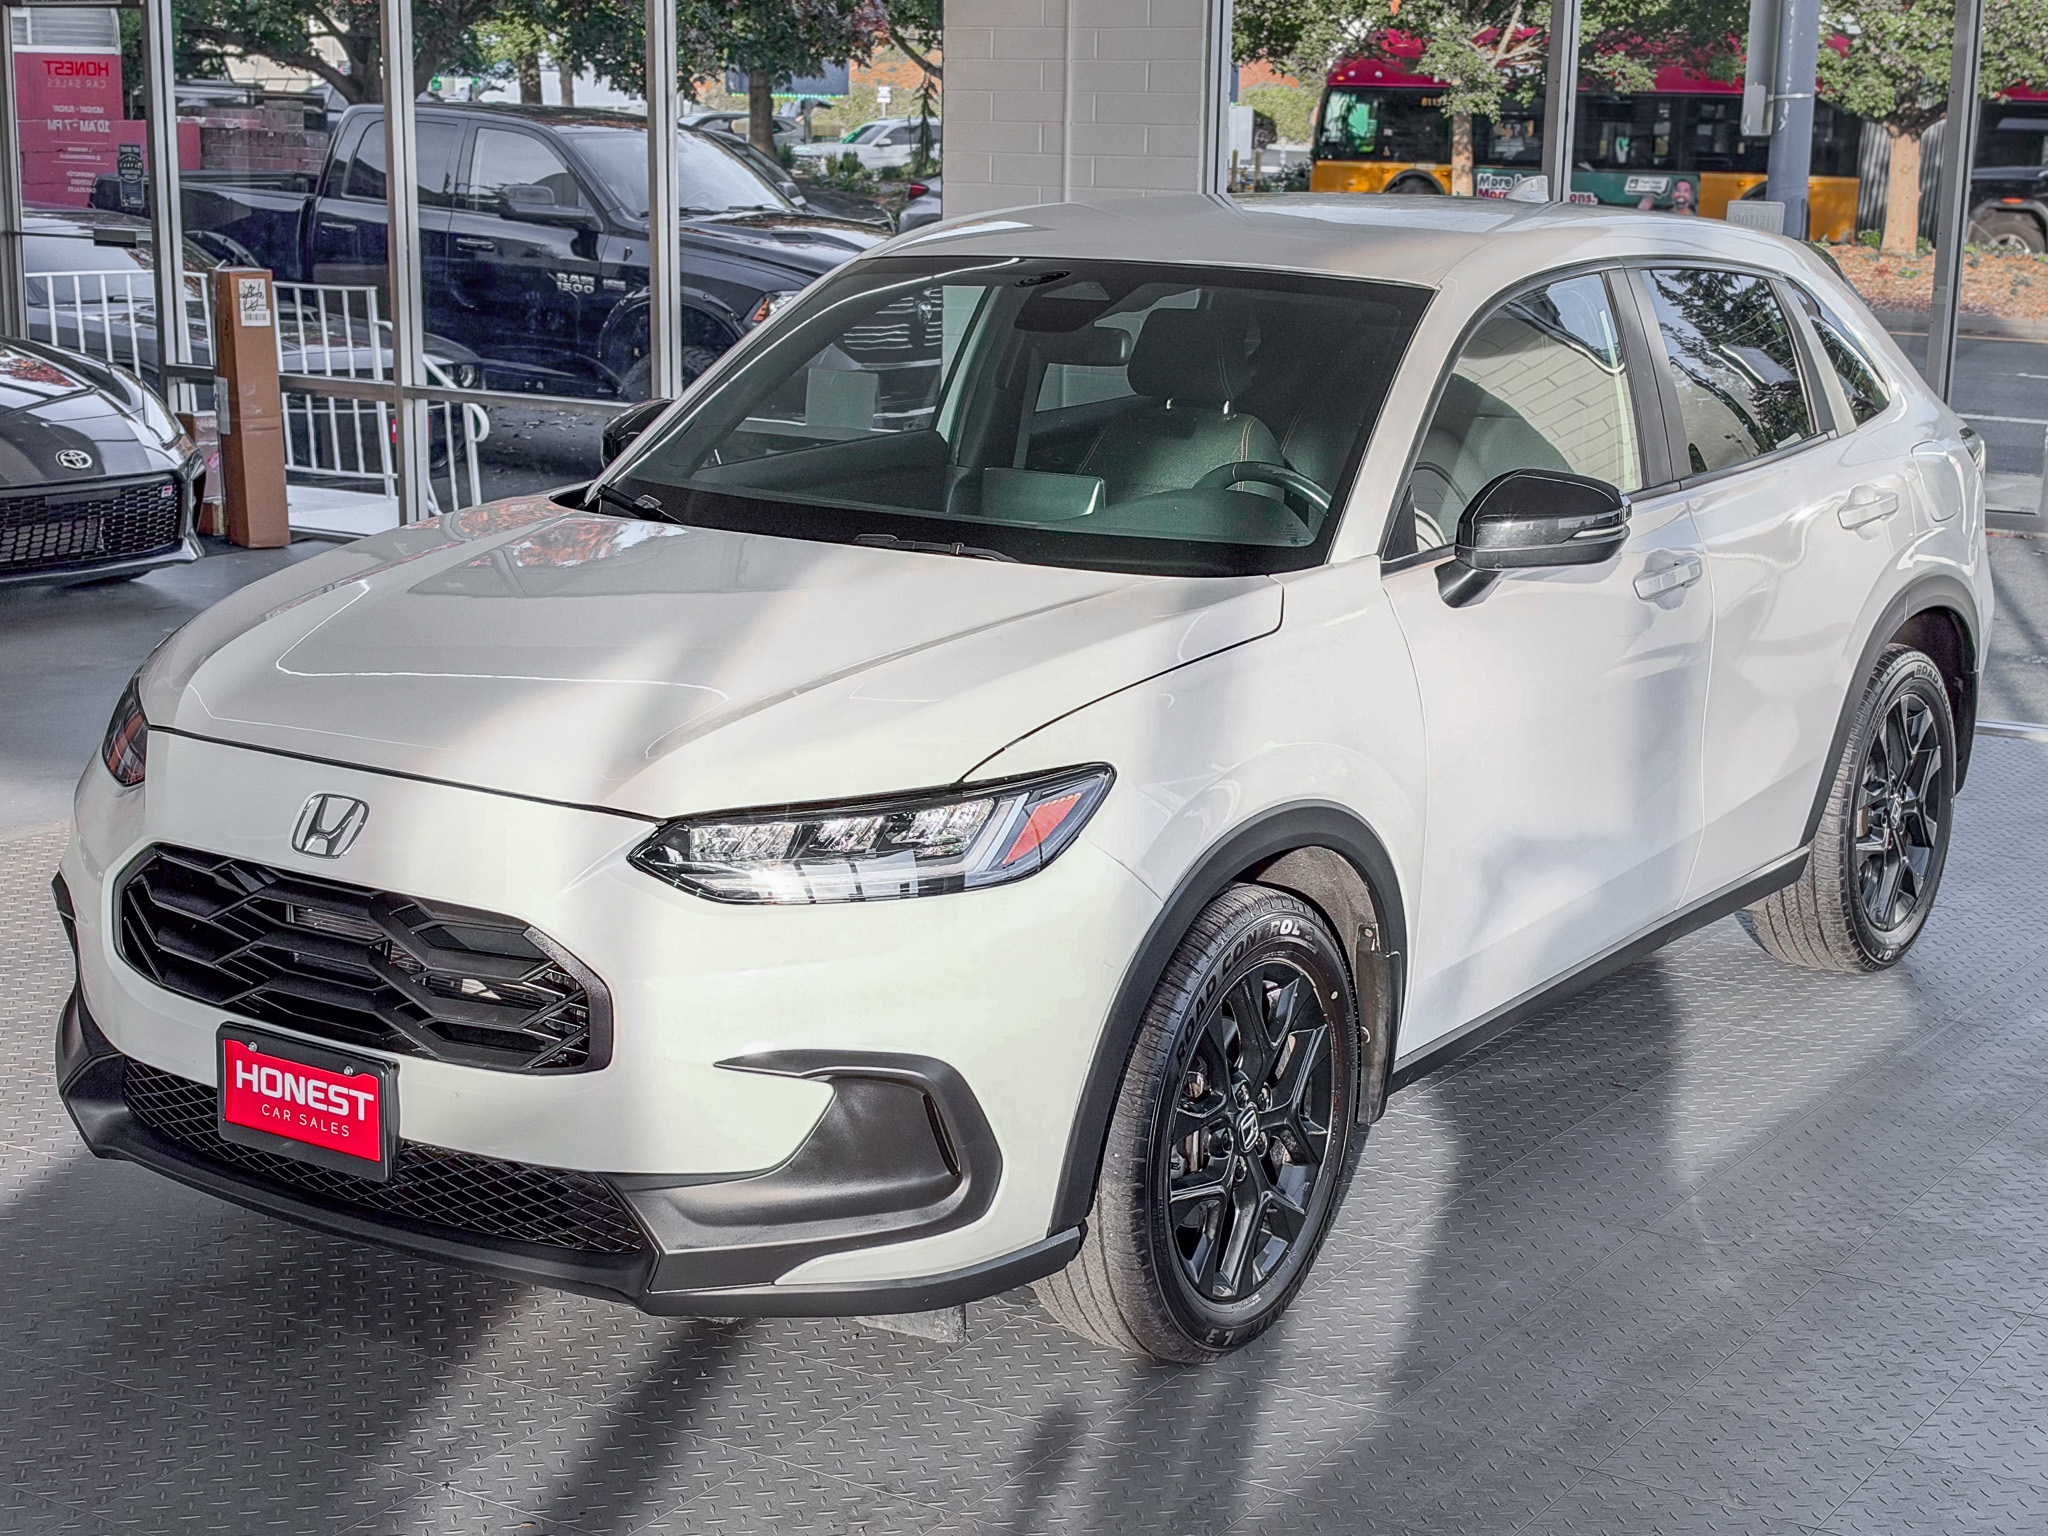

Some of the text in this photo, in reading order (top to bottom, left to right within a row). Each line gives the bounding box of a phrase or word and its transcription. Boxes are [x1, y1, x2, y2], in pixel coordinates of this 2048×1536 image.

[1479, 174, 1512, 188] More
[1478, 188, 1510, 199] Mor
[556, 281, 595, 294] 1500
[1915, 664, 1939, 685] ROAD
[235, 1059, 374, 1122] HONEST
[261, 1103, 350, 1138] CAR SALES
